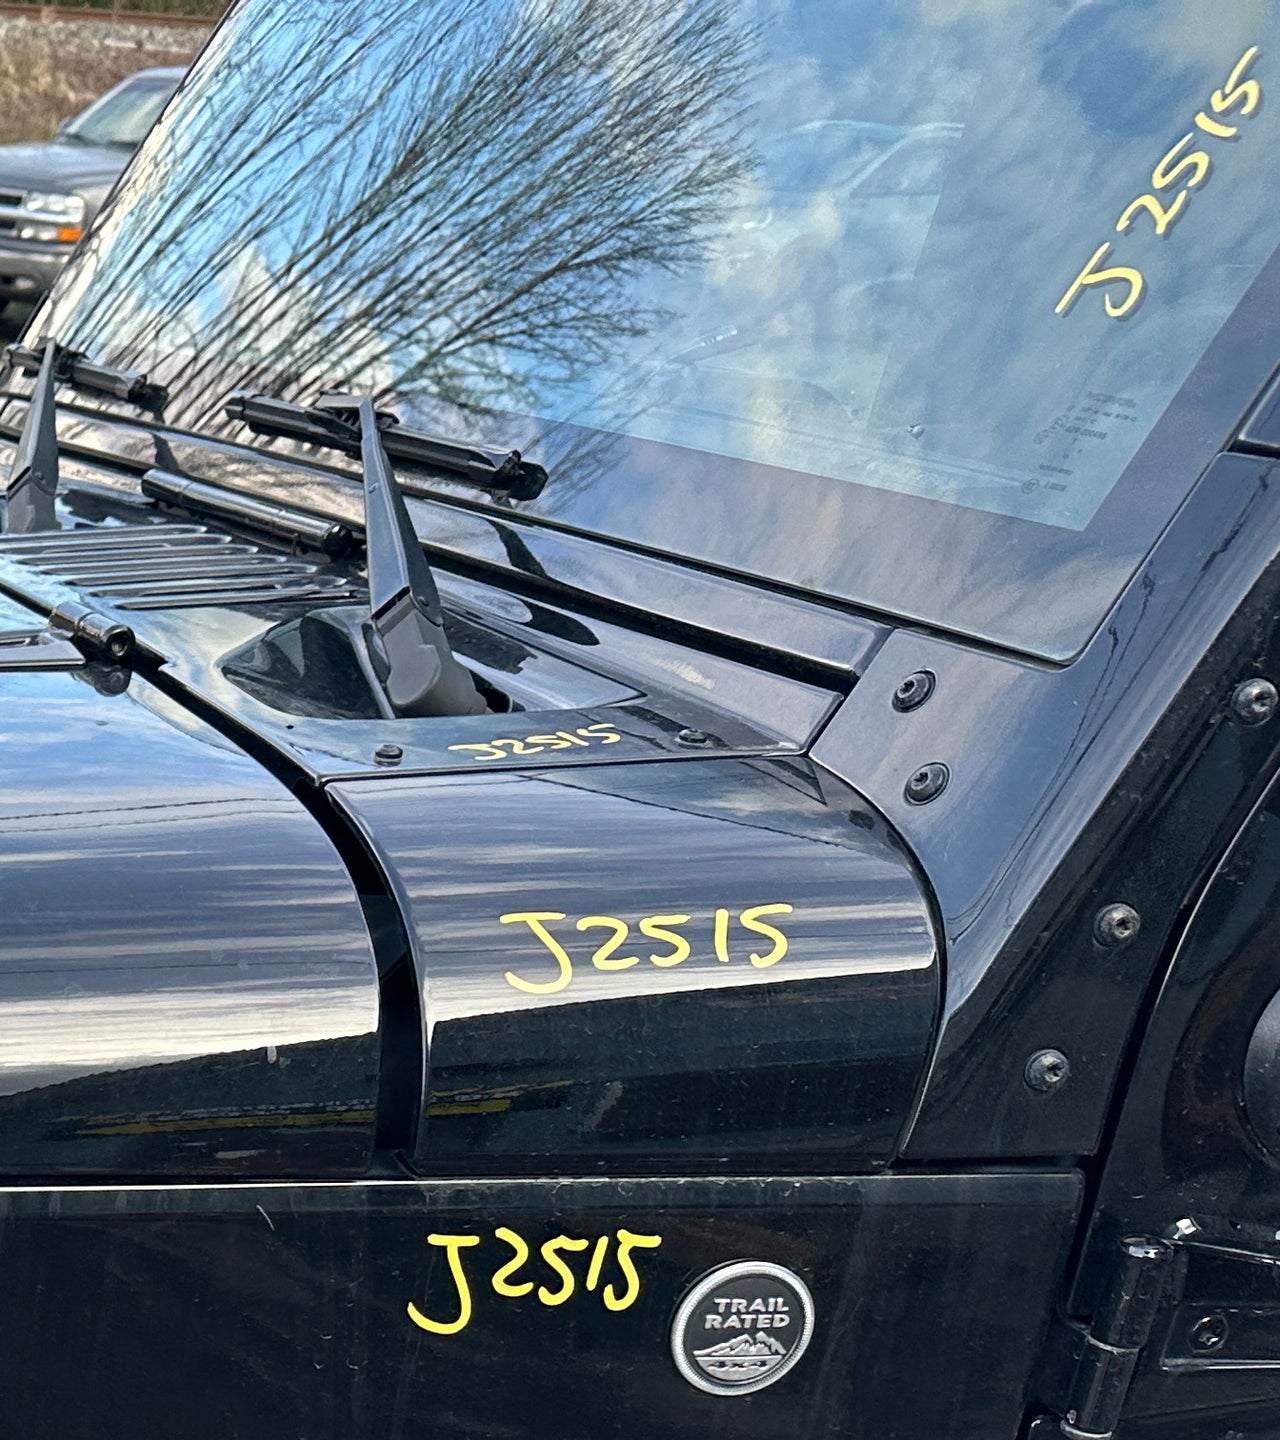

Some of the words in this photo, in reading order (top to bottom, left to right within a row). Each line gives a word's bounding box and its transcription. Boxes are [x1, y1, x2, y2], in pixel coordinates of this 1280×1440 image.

[1054, 45, 1260, 317] J2515
[448, 723, 621, 761] J2515
[499, 904, 793, 994] J2515
[407, 1228, 662, 1334] J2515
[714, 1297, 789, 1313] TRAIL
[704, 1314, 790, 1330] RATED
